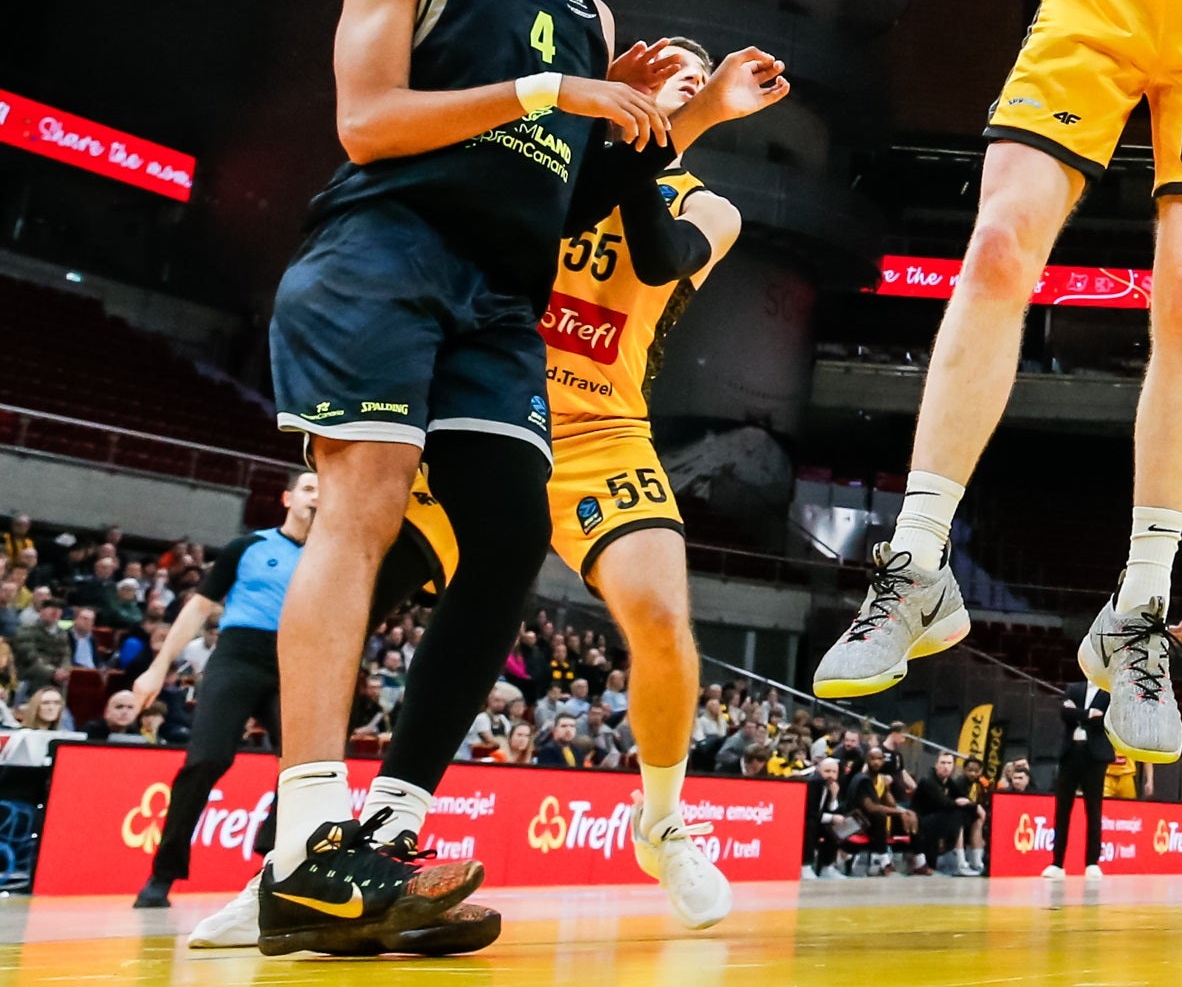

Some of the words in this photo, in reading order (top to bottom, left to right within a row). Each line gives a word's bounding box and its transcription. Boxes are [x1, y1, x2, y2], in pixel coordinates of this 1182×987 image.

[530, 11, 556, 64] 4
[1053, 111, 1082, 125] 4F
[563, 228, 623, 282] 55
[905, 266, 943, 287] the
[557, 307, 618, 350] Trefl
[546, 366, 613, 397] d.Travel
[360, 401, 409, 416] SPALDING
[606, 468, 668, 510] 55
[436, 835, 476, 860] trefl
[565, 800, 633, 860] Trefl
[1033, 816, 1056, 852] Tre
